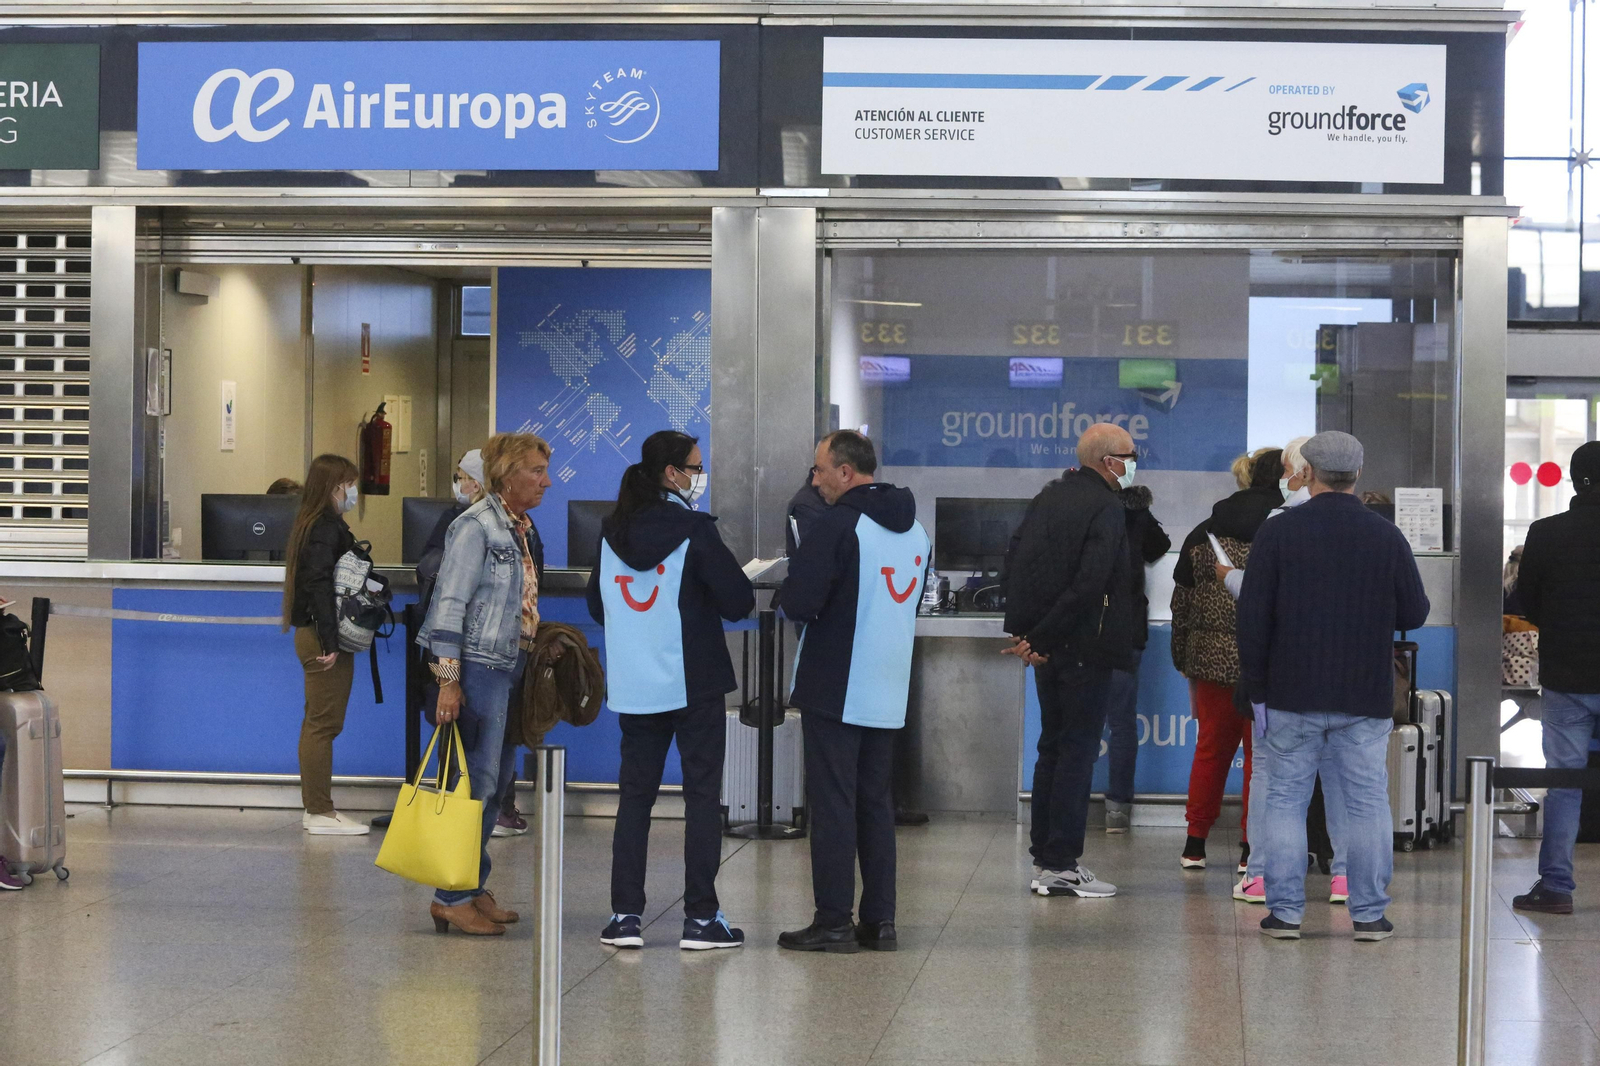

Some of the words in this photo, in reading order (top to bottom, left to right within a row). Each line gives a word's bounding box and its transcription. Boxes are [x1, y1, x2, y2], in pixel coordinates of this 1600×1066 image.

[1268, 84, 1320, 96] OPERATED
[1321, 85, 1336, 96] BY
[854, 107, 915, 122] ATENCIÓN
[917, 109, 934, 122] AL
[936, 110, 986, 123] CLIENTE
[1267, 104, 1407, 136] groundforce
[854, 127, 921, 140] CUSTOMER
[923, 128, 976, 141] SERVICE
[1326, 133, 1341, 142] We
[1342, 133, 1375, 143] handle,
[1376, 136, 1393, 144] you
[1394, 134, 1409, 145] fly.
[1030, 443, 1050, 455] We
